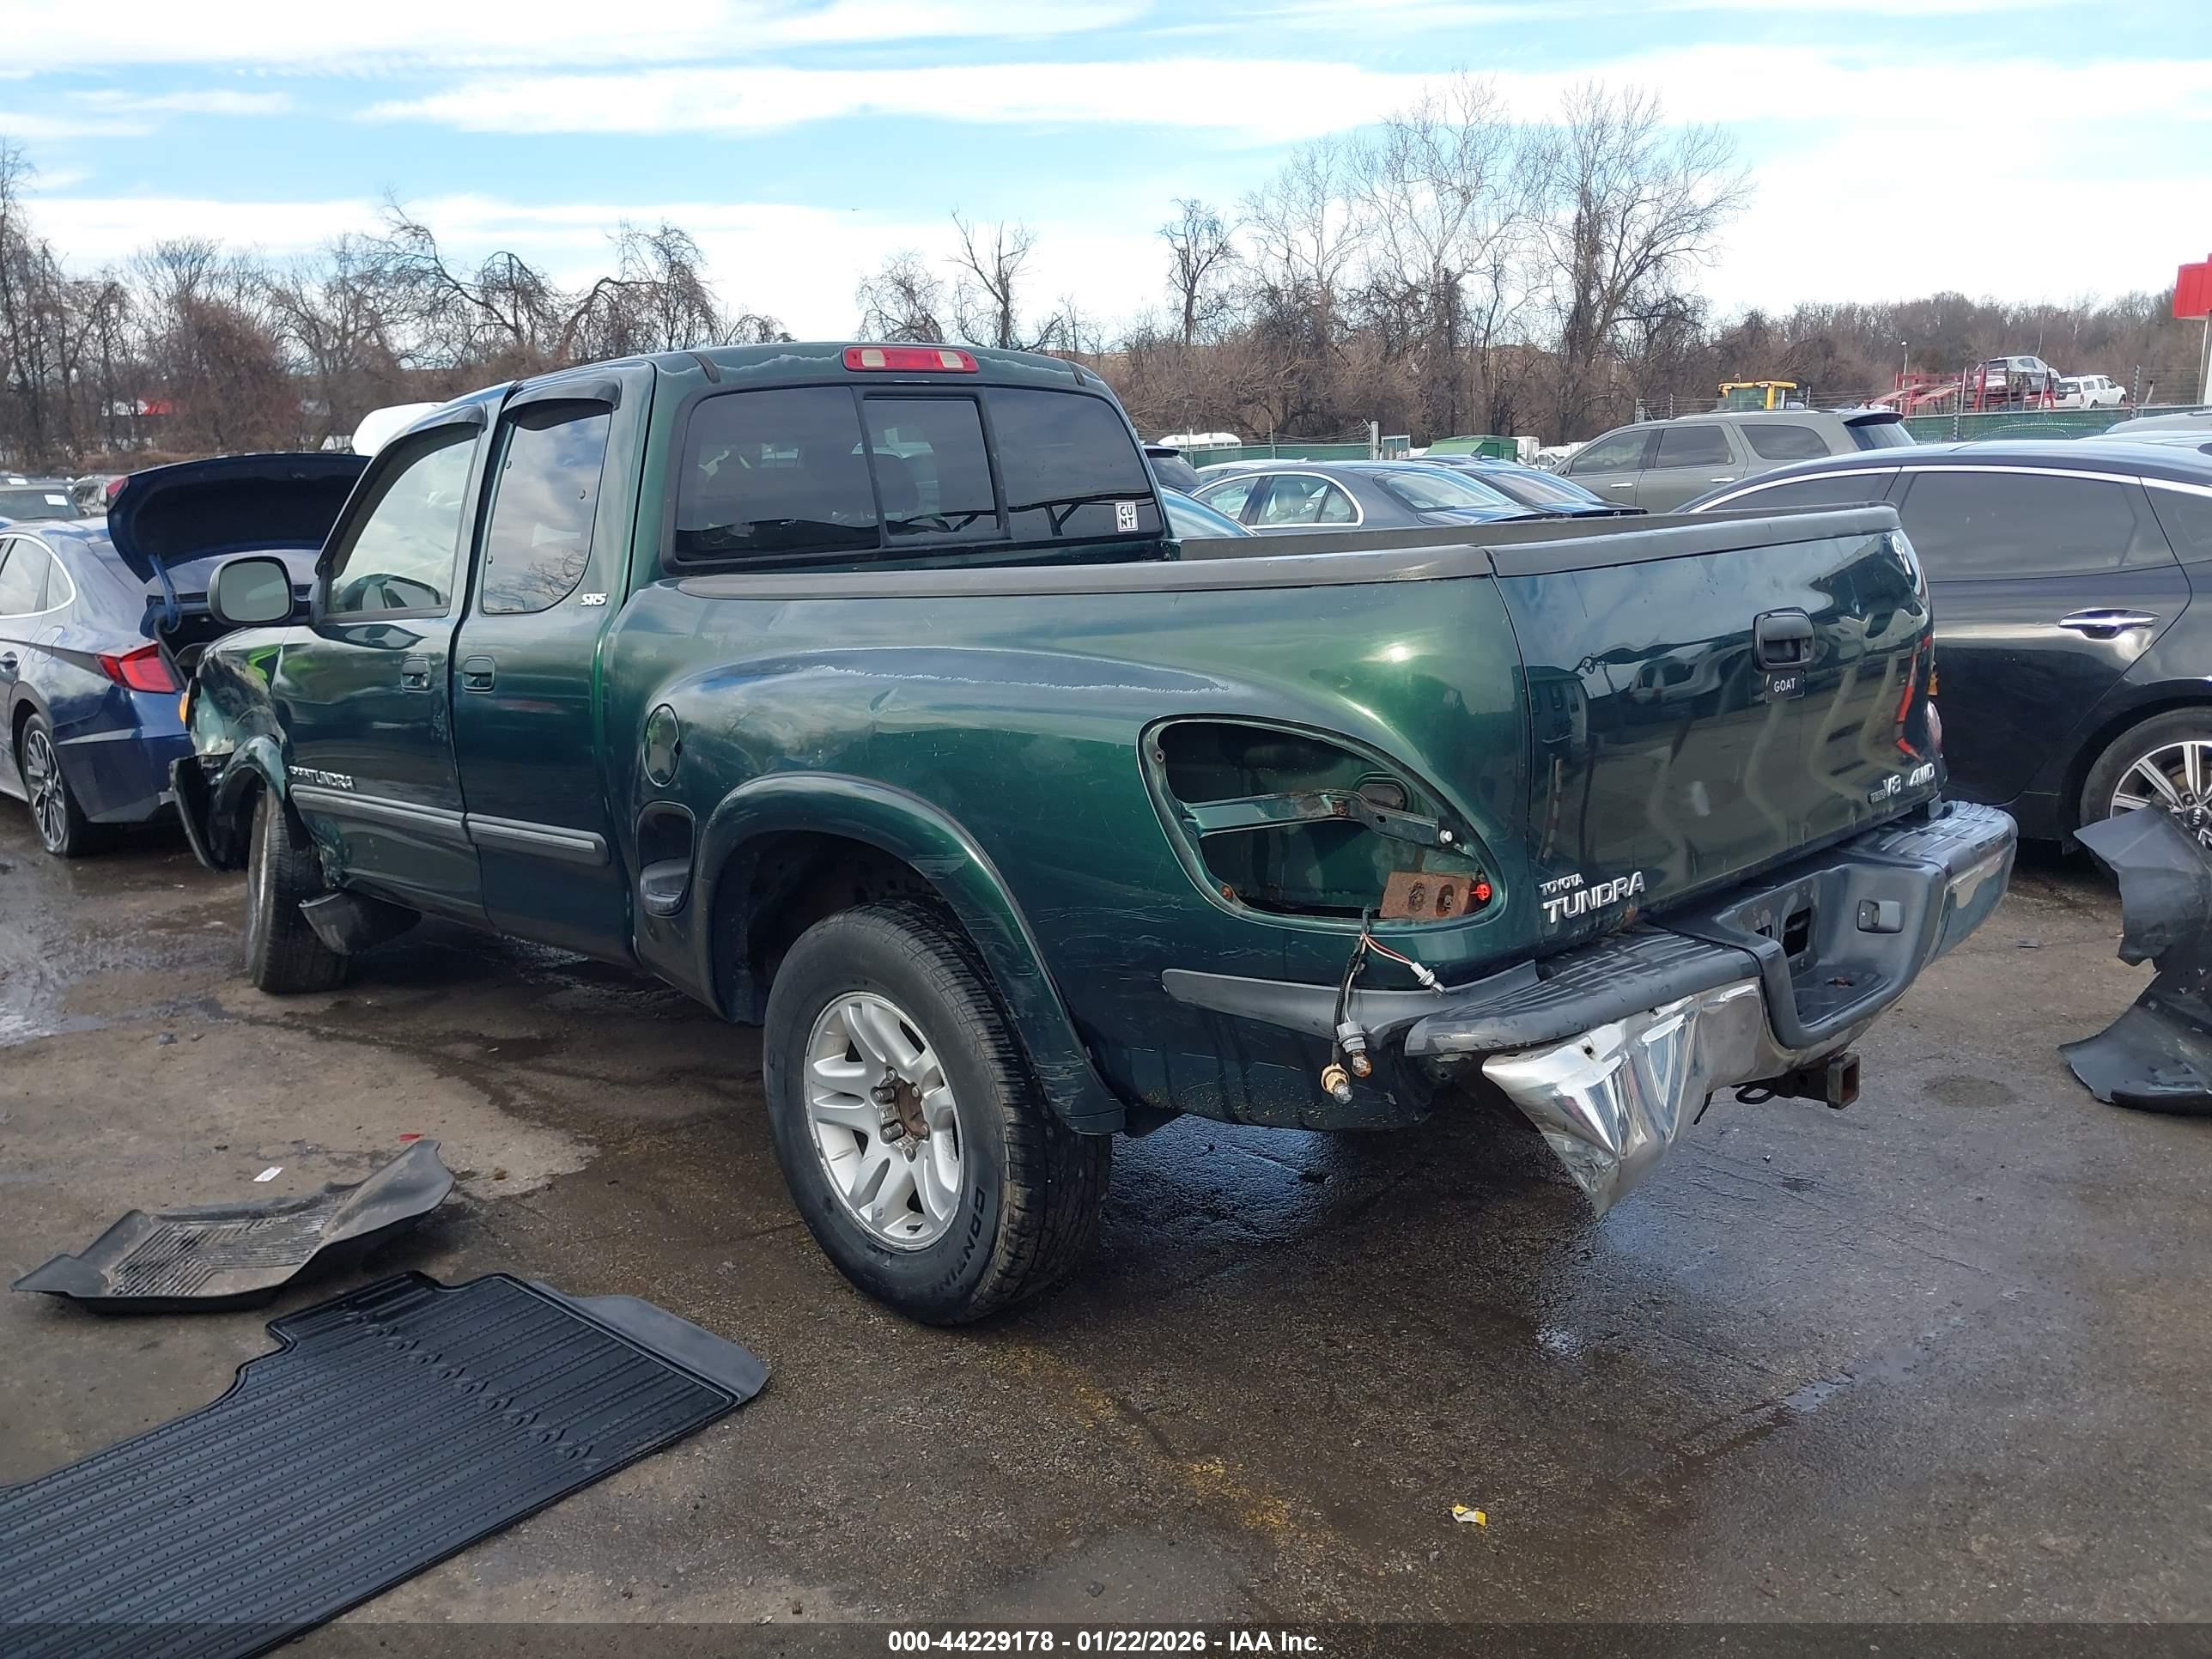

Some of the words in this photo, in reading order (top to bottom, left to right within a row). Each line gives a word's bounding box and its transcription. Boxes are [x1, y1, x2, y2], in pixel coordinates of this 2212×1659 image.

[1120, 506, 1133, 517] CU
[1121, 517, 1134, 528] NT
[580, 592, 608, 606] SR5
[1773, 678, 1796, 693] GOAT
[1882, 775, 1901, 797] V8
[1908, 763, 1935, 787] 4WD
[1539, 872, 1584, 896] TOYOTA
[1542, 871, 1645, 924] TUNDRA
